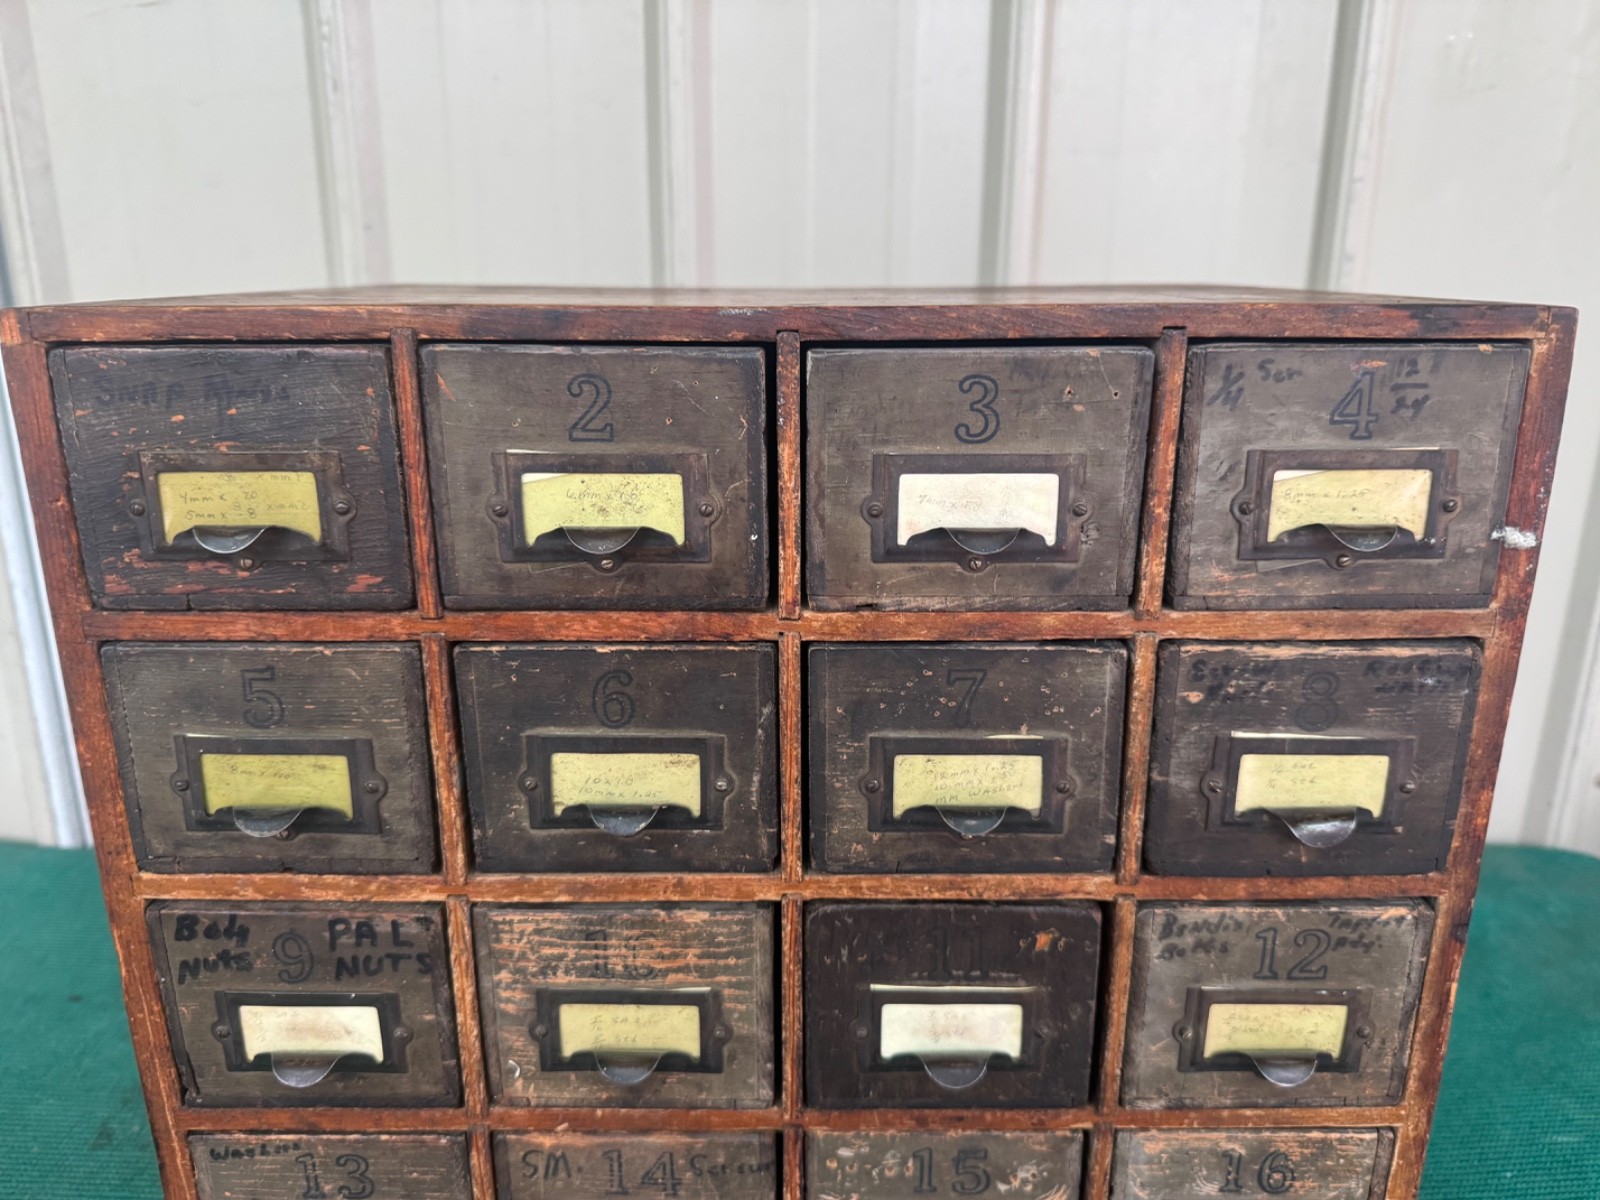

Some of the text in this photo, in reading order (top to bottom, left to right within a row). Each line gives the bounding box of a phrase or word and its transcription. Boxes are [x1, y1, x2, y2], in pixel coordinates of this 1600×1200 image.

[567, 373, 614, 442] 2
[953, 373, 1002, 445] 3
[1329, 370, 1380, 440] 4
[240, 665, 285, 729] 5
[592, 669, 636, 729] 6
[946, 668, 988, 728] 7
[1293, 671, 1340, 731] 8
[272, 928, 316, 984] 9
[335, 952, 433, 981] NUTS
[1252, 926, 1333, 981] 12
[296, 1153, 376, 1200] 13
[600, 1148, 684, 1197] 14
[912, 1146, 992, 1195] 15
[1218, 1149, 1296, 1195] 16
